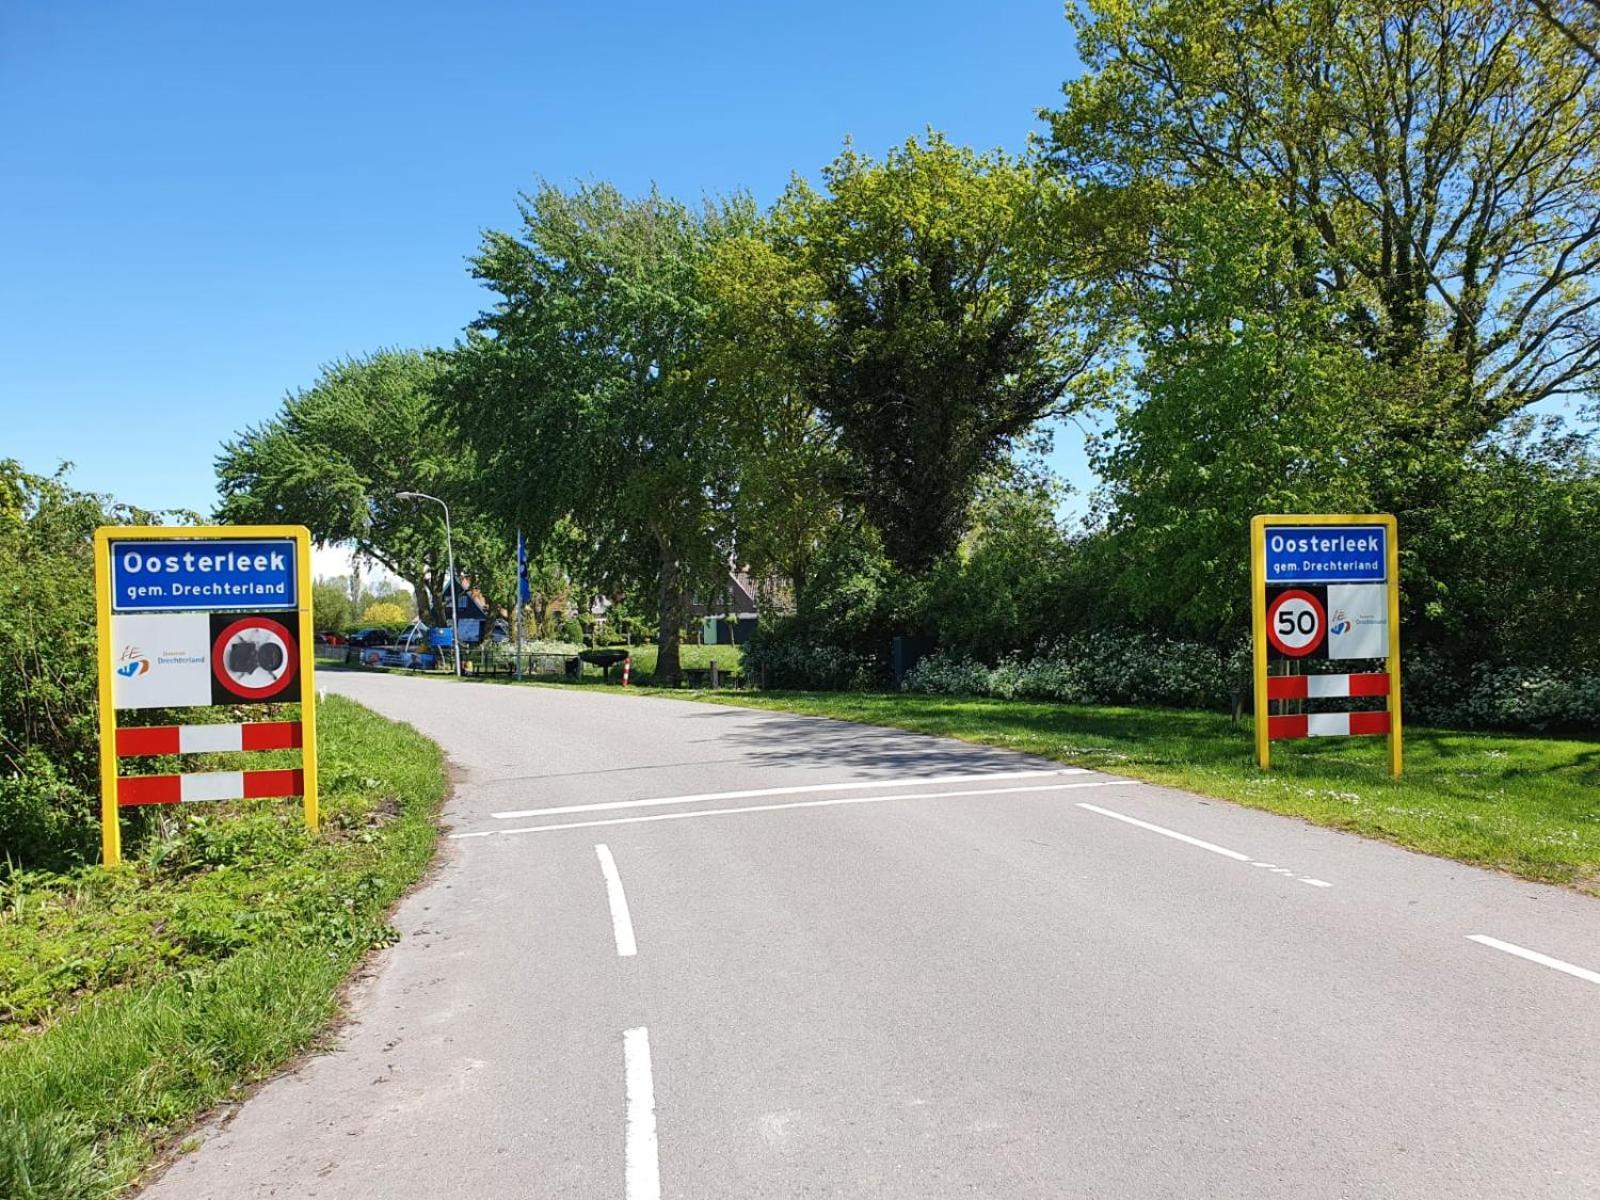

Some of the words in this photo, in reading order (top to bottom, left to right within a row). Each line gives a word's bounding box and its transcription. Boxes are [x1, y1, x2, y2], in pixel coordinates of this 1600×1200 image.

[1271, 535, 1379, 552] Oosterleek
[123, 550, 286, 574] Oosterleek
[1273, 562, 1300, 574] gem.
[1303, 560, 1378, 571] Drechterland
[127, 585, 168, 599] gem.
[172, 581, 285, 596] Drechterland
[1278, 610, 1315, 636] 50
